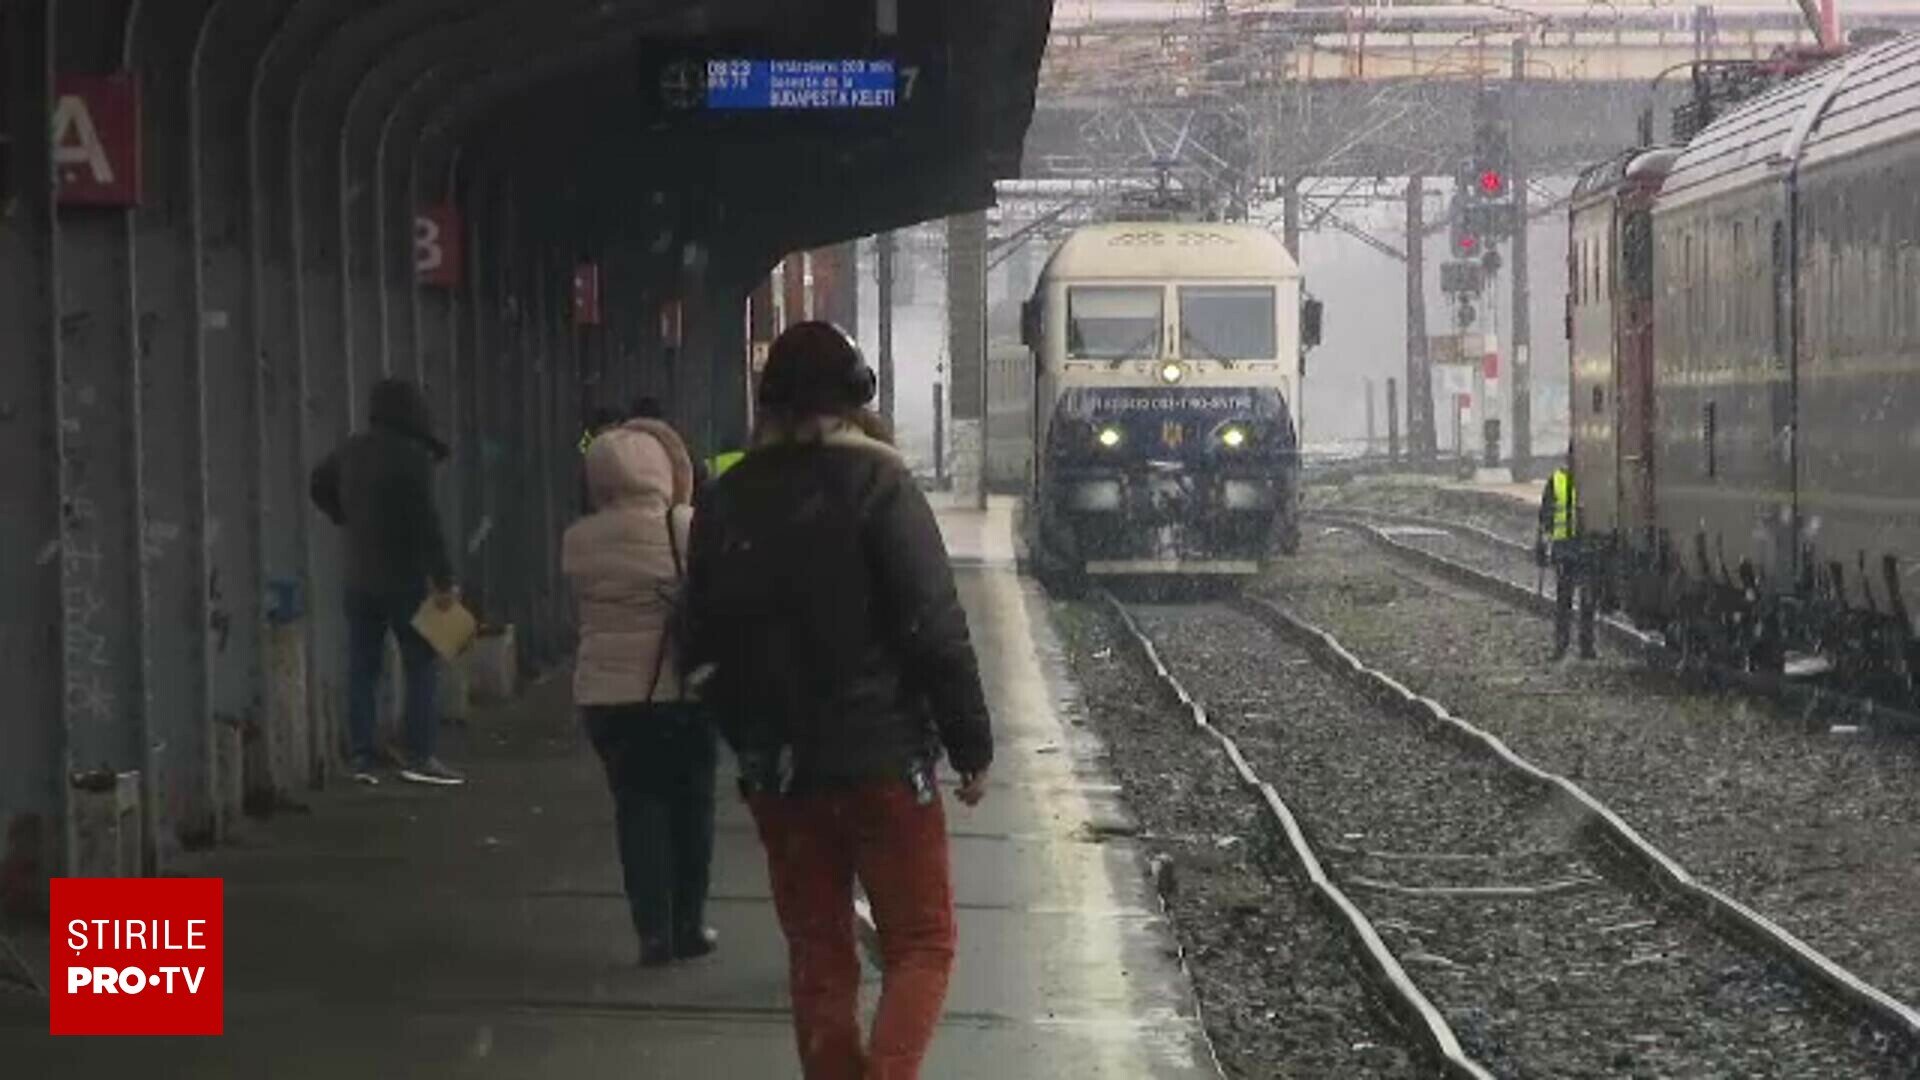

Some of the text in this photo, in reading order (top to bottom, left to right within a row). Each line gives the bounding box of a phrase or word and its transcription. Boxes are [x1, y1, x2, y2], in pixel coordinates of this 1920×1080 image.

[852, 90, 895, 107] KELETI
[900, 66, 920, 100] 7
[51, 95, 114, 183] A
